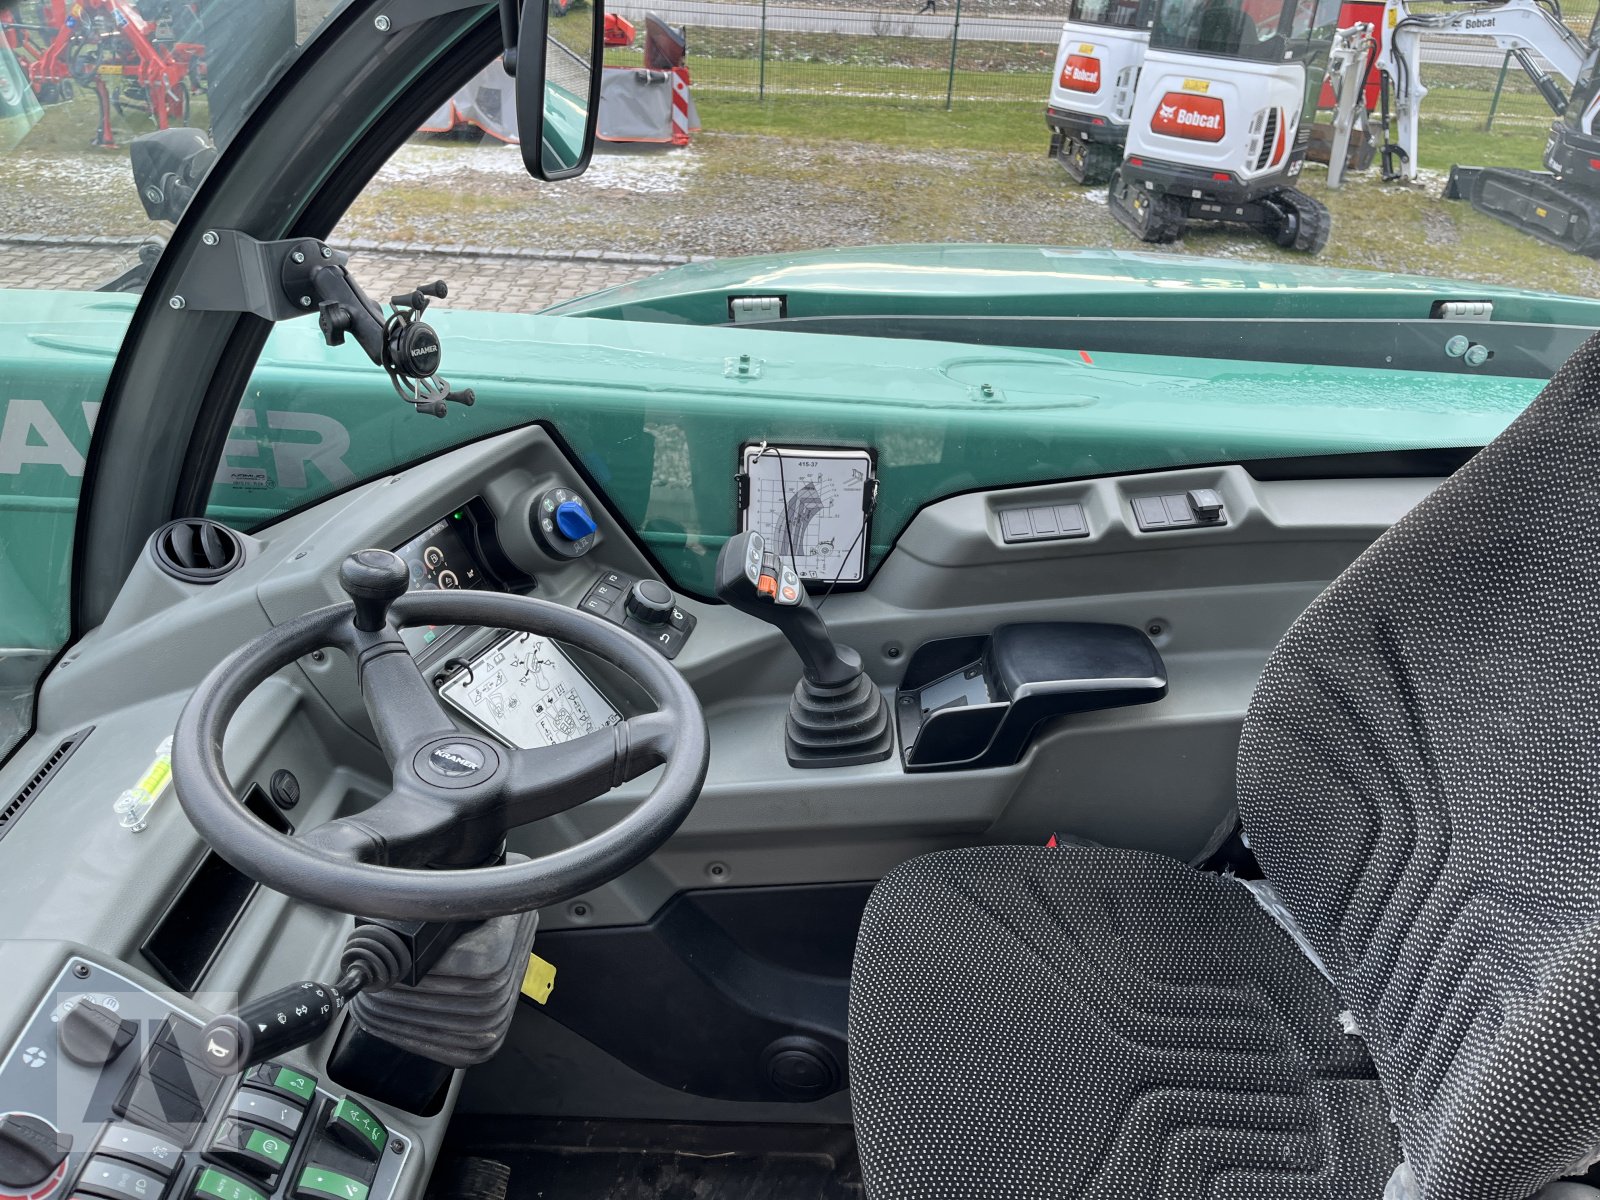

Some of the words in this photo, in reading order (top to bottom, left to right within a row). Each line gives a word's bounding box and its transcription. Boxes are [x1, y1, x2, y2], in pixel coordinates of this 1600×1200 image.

[1465, 17, 1496, 29] Bobcat
[1073, 67, 1099, 83] Bobcat
[1176, 109, 1222, 129] Bobcat
[411, 344, 438, 357] KRAMER
[608, 574, 618, 582] F3
[598, 586, 608, 594] F2
[588, 600, 598, 608] F1
[434, 749, 478, 770] KRAMER
